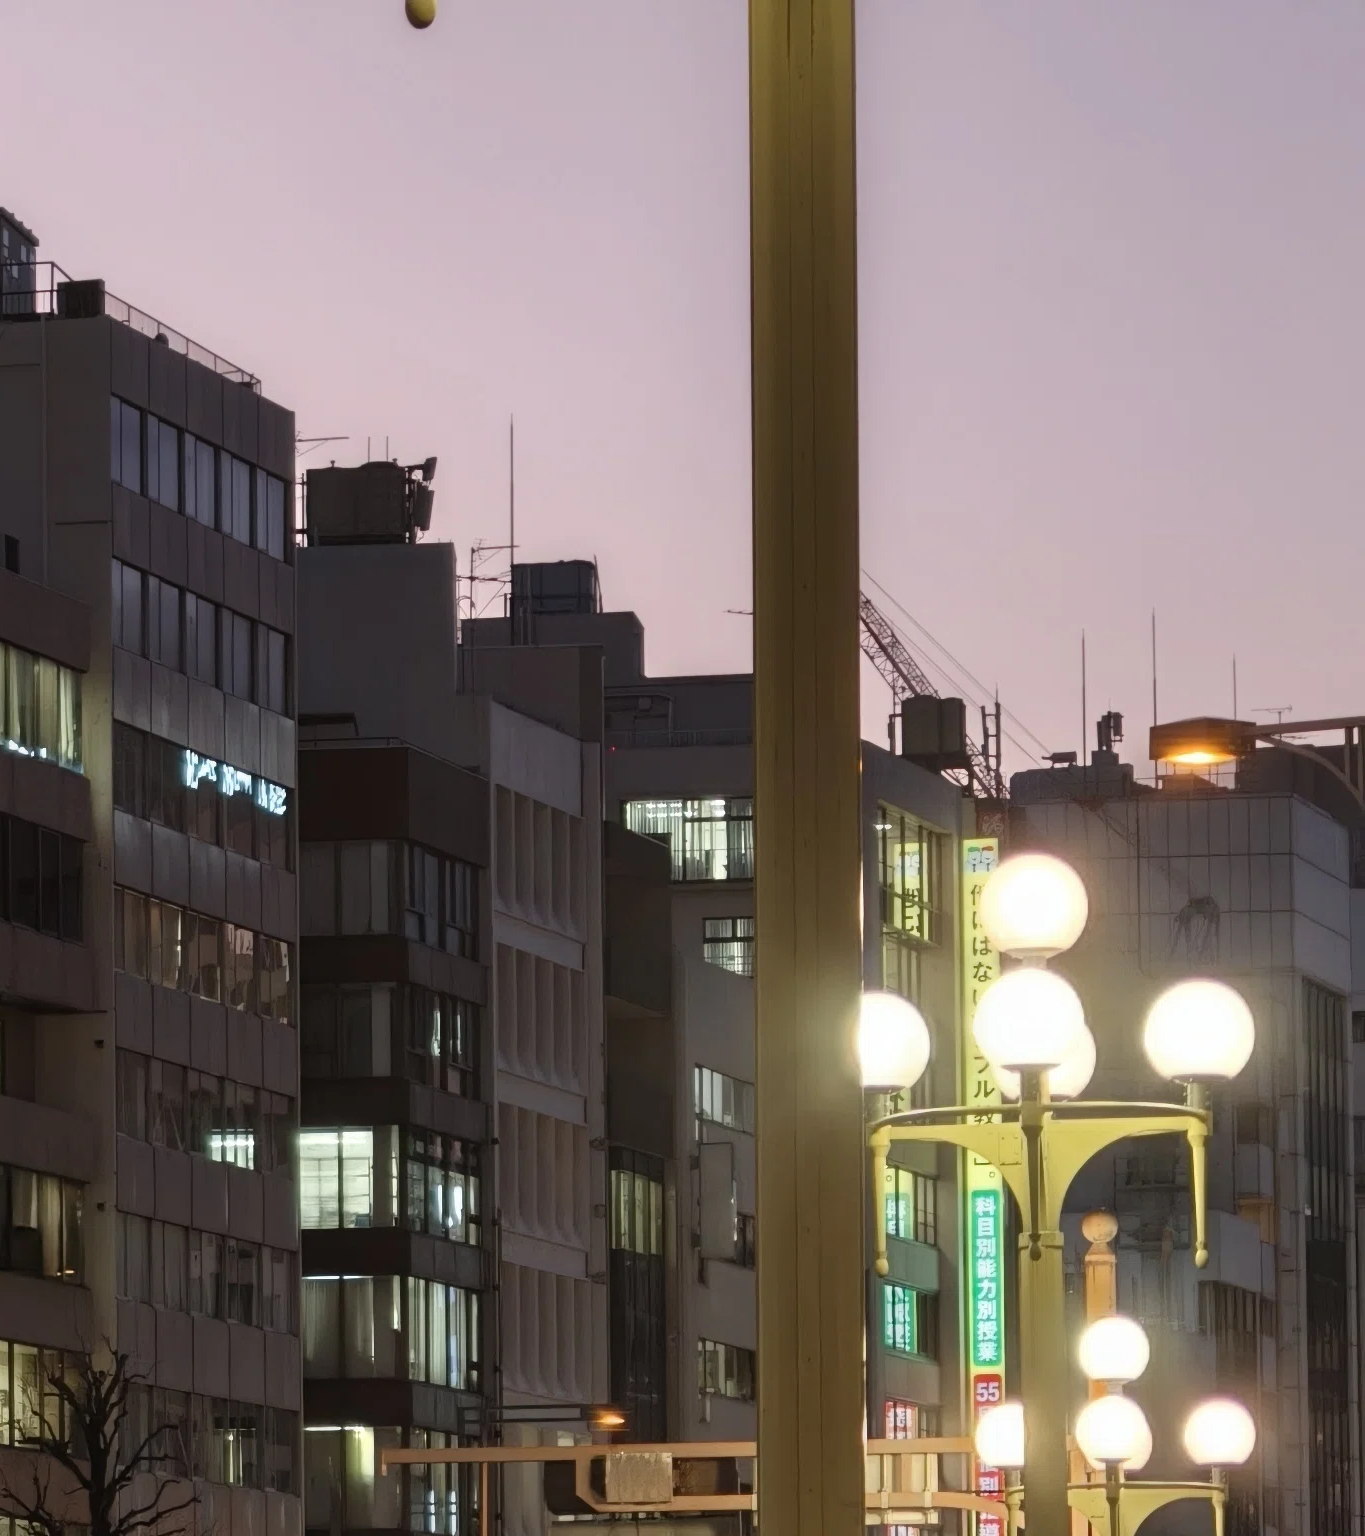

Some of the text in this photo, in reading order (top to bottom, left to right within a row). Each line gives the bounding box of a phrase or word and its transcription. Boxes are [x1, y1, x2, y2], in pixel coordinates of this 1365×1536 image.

[975, 1196, 997, 1362] 科目別能力別授業
